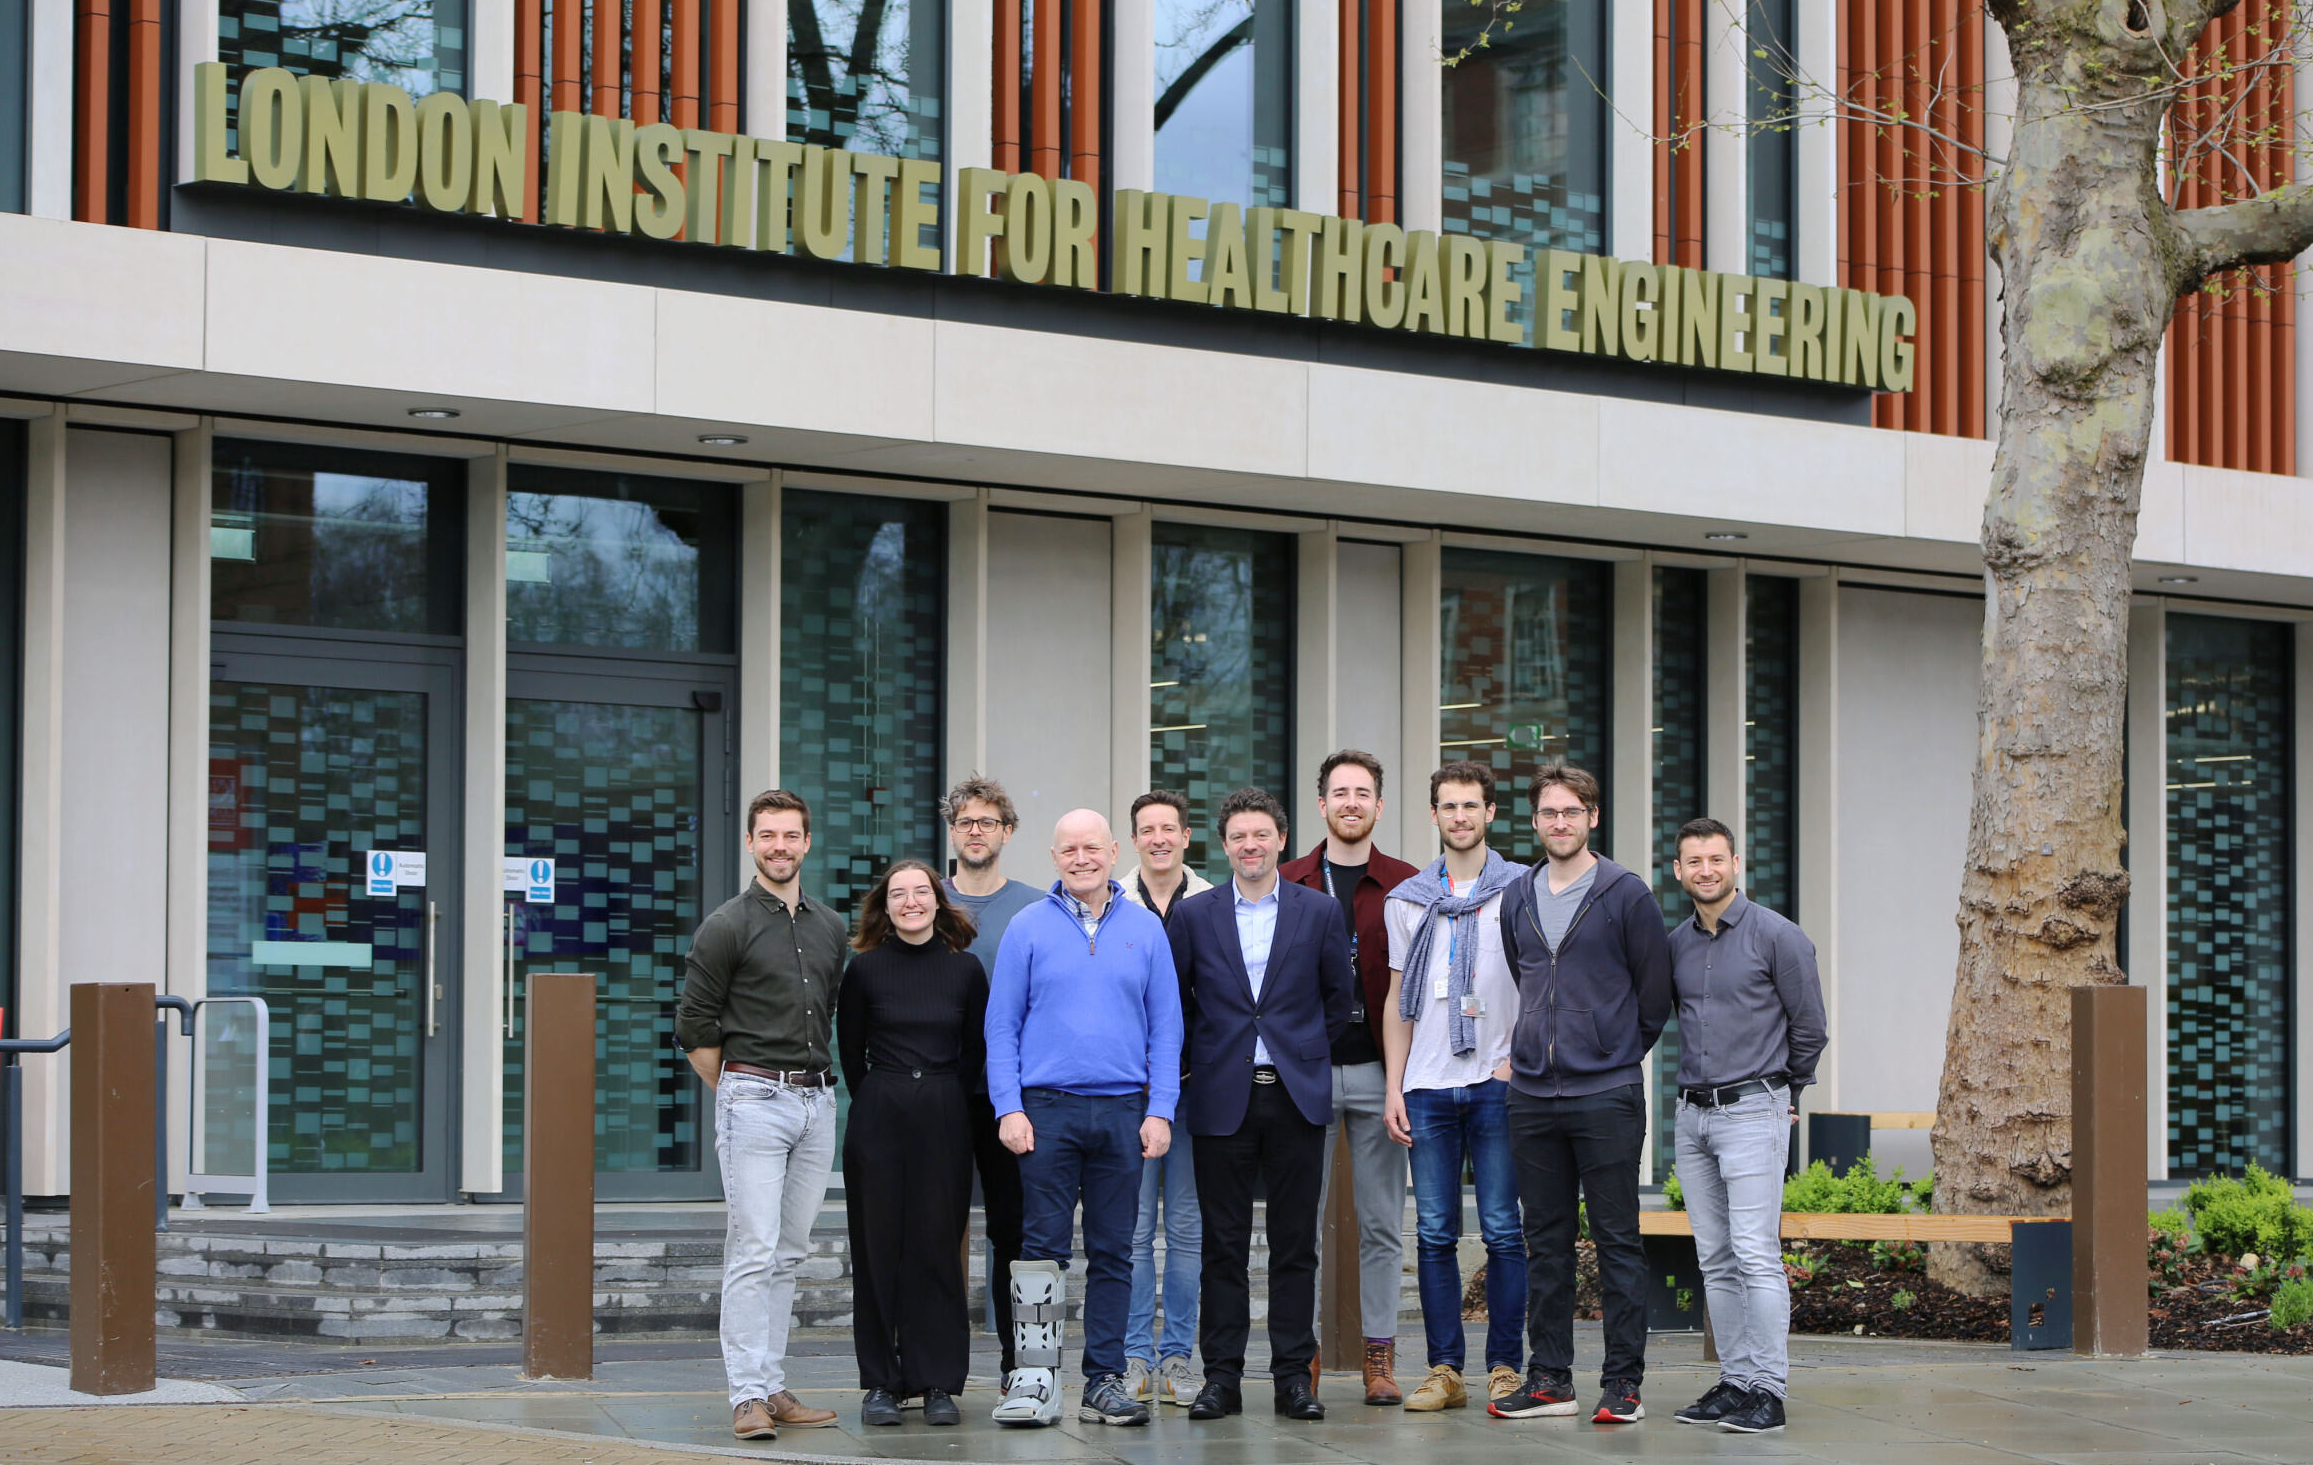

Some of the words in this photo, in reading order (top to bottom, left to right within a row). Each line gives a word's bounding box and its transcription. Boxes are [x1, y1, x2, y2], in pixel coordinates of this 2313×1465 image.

[195, 62, 527, 219] LONDON
[545, 110, 942, 271] INSTITUTE
[956, 167, 1098, 289] FOR
[1112, 189, 1525, 343] HEALTHCARE
[1533, 249, 1917, 393] ENGINEERING
